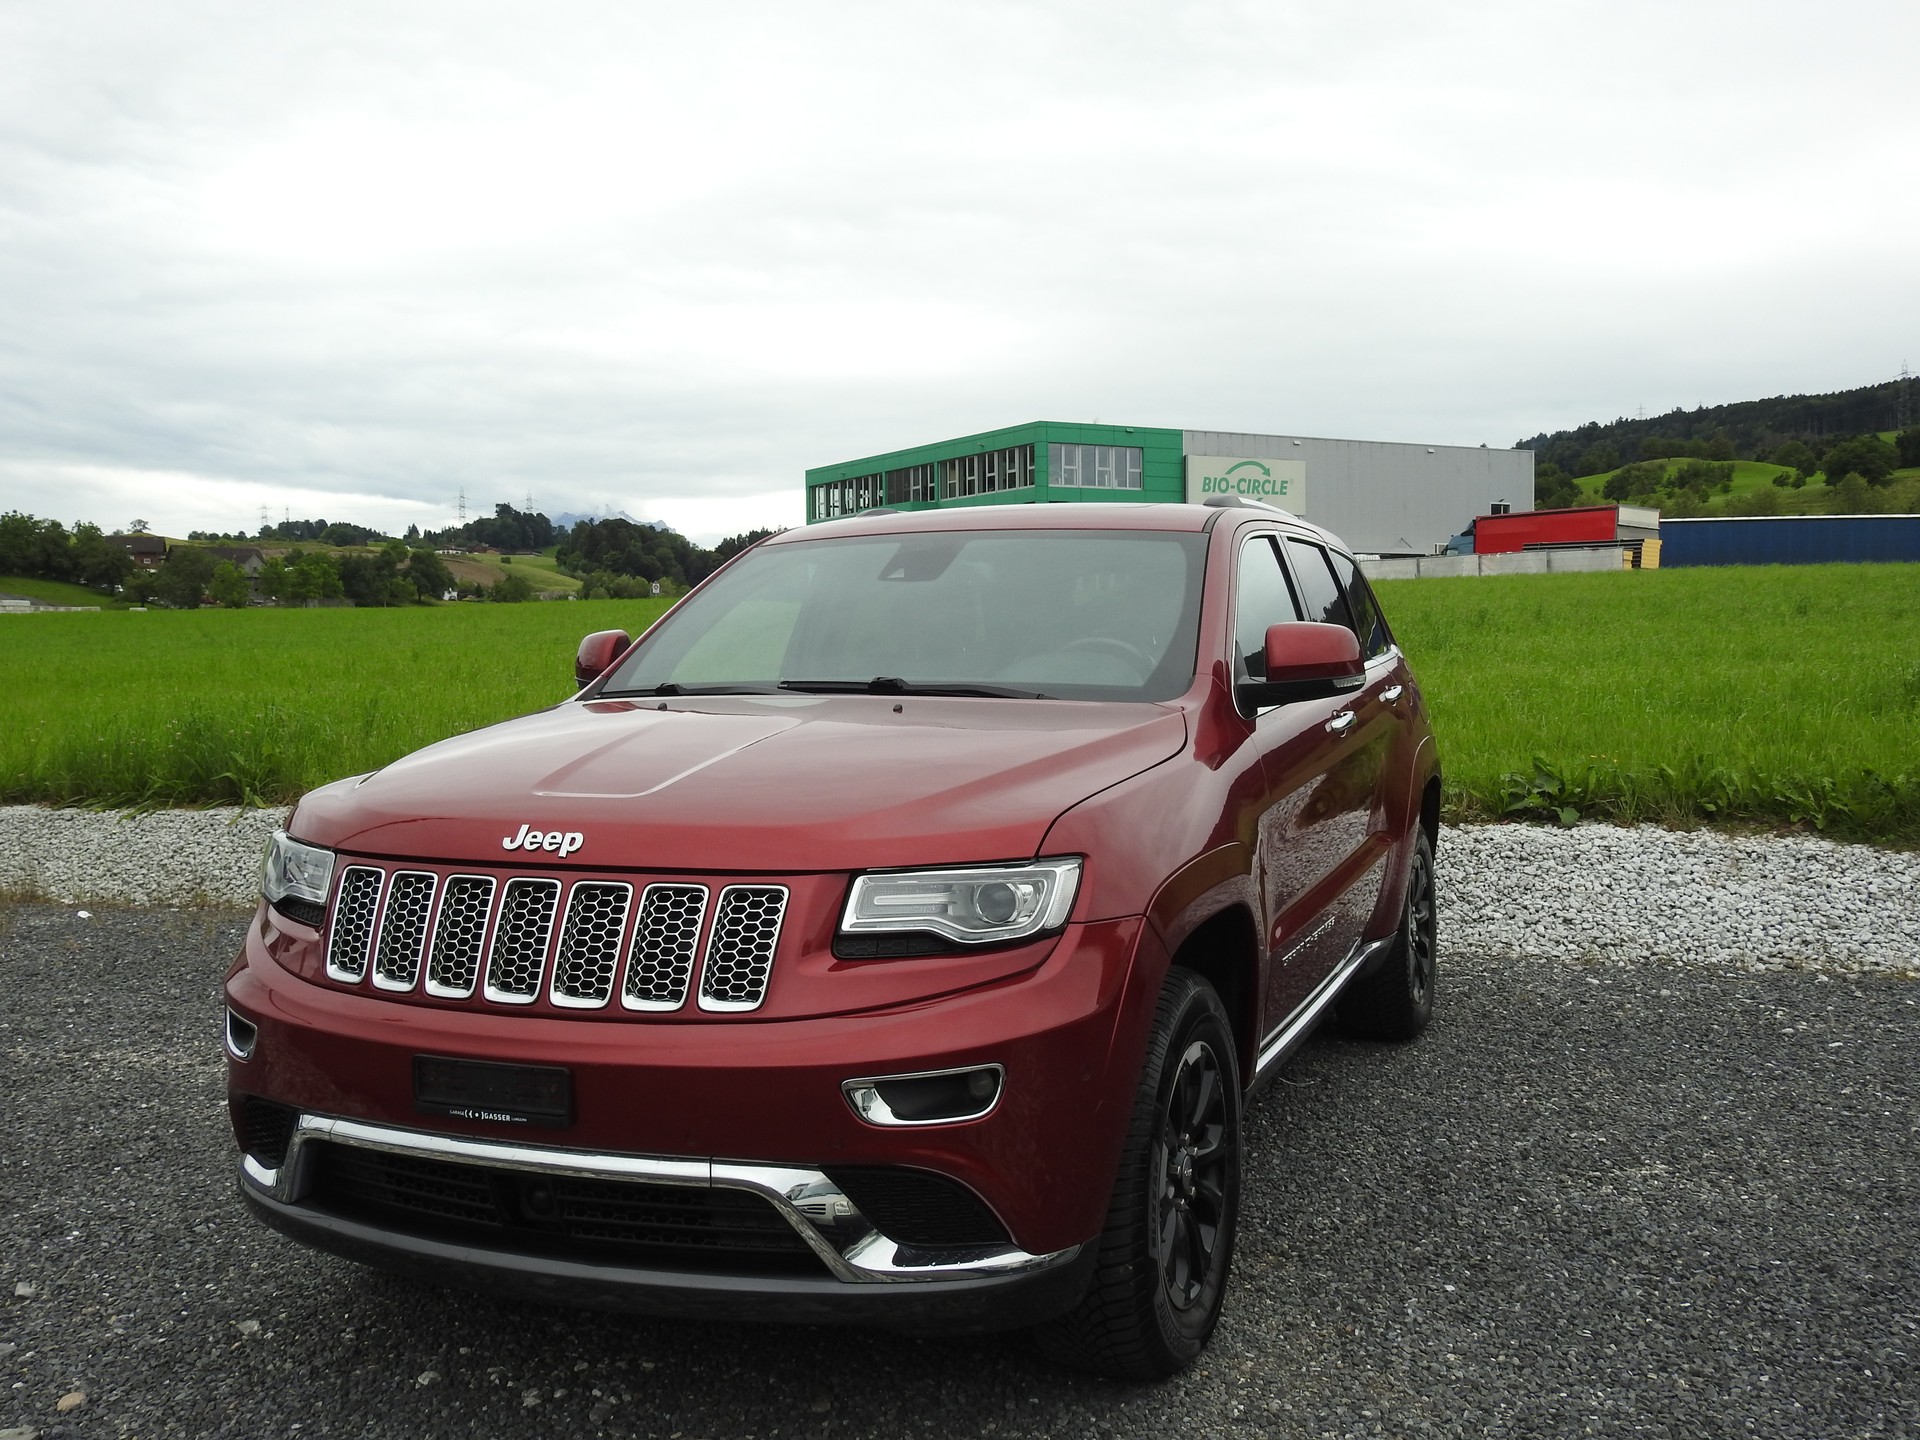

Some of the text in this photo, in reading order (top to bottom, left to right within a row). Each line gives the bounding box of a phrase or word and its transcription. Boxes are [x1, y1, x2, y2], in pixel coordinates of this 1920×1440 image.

[1202, 476, 1289, 496] BIO-CIRCLE
[502, 824, 584, 858] Jeep
[484, 1112, 511, 1122] GASSER
